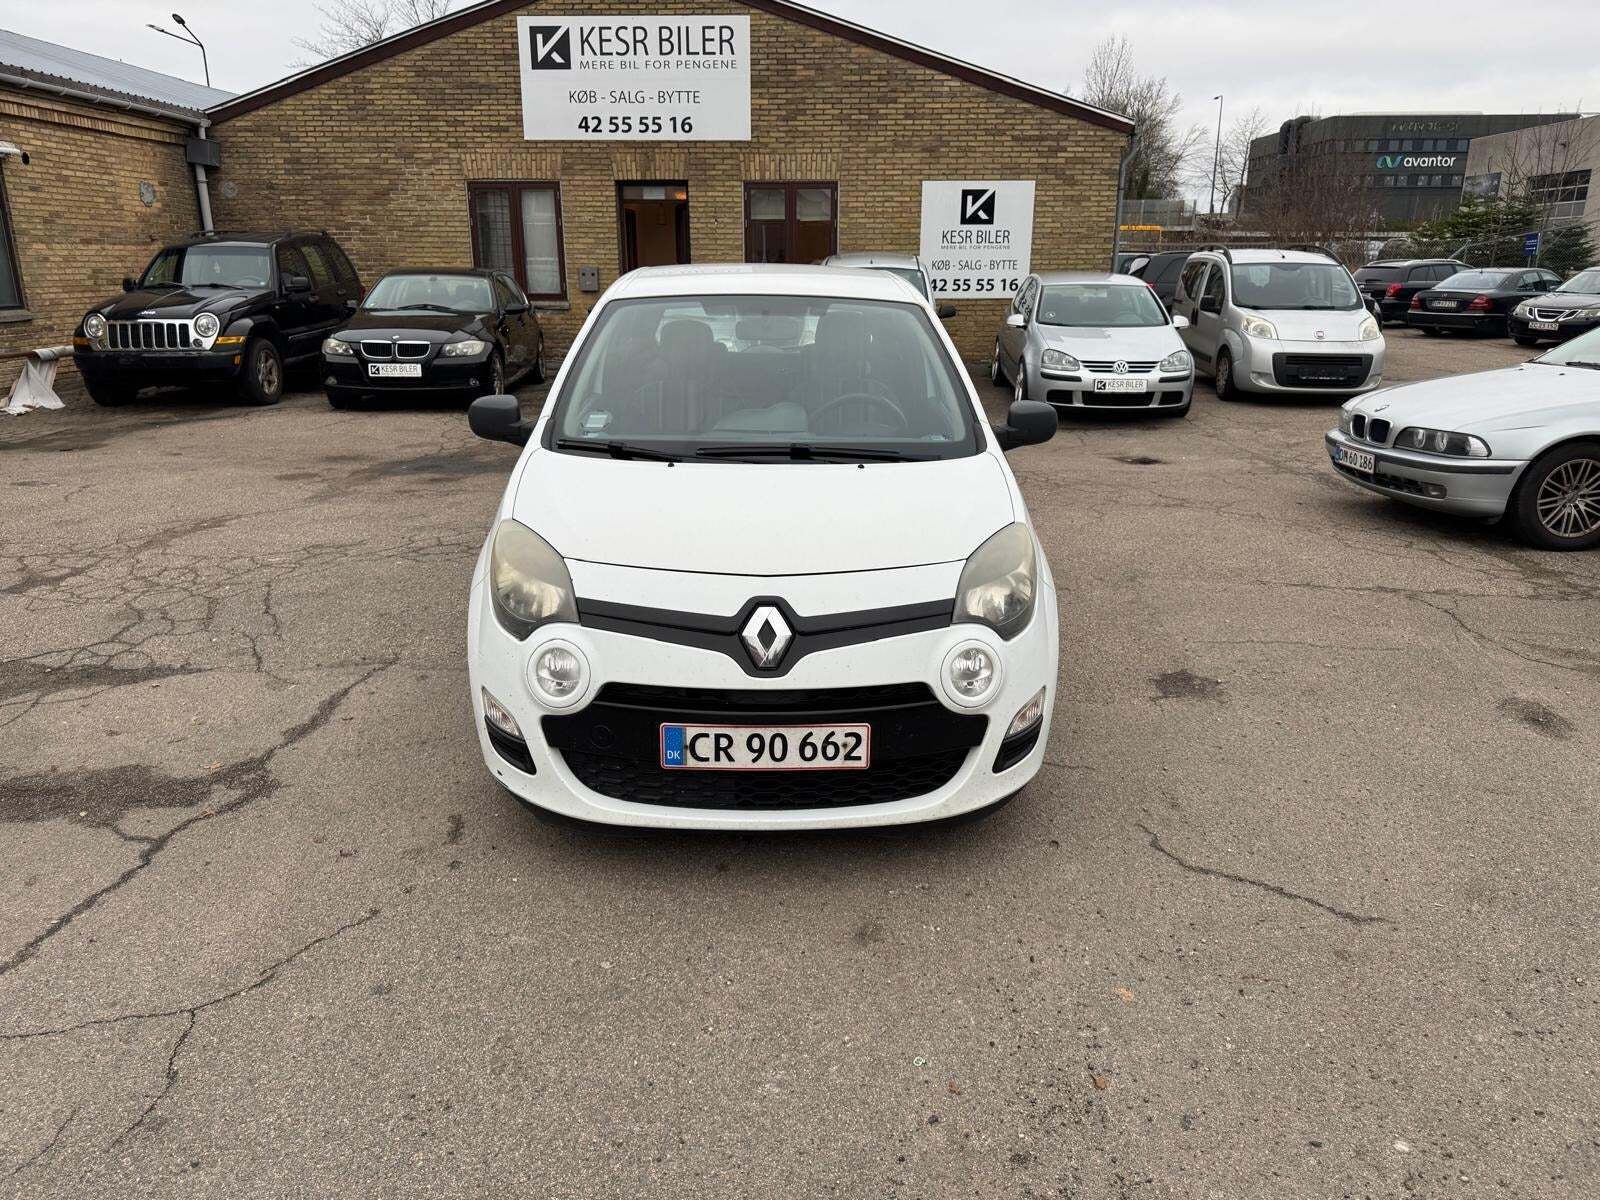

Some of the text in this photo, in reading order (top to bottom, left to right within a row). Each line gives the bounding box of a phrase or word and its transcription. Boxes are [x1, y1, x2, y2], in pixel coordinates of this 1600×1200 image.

[580, 25, 735, 56] KESR BILER
[579, 59, 737, 70] MERE BIL FOR PENGENE
[568, 90, 598, 104] KØB
[609, 90, 645, 104] SALG
[658, 90, 701, 104] BYTTE
[578, 116, 693, 133] 42 55 55 16
[1403, 155, 1457, 167] avantor
[941, 230, 1010, 244] KESR BILER
[931, 260, 951, 271] KØB
[958, 260, 982, 270] SALG
[989, 260, 1018, 270] BYTTE
[931, 279, 1019, 292] 42 55 55 16
[381, 365, 398, 373] KESR
[398, 365, 418, 373] BILER
[1107, 380, 1125, 388] KESR
[1125, 380, 1144, 388] BILER
[689, 731, 863, 763] CR 90 662
[667, 751, 681, 760] DK
